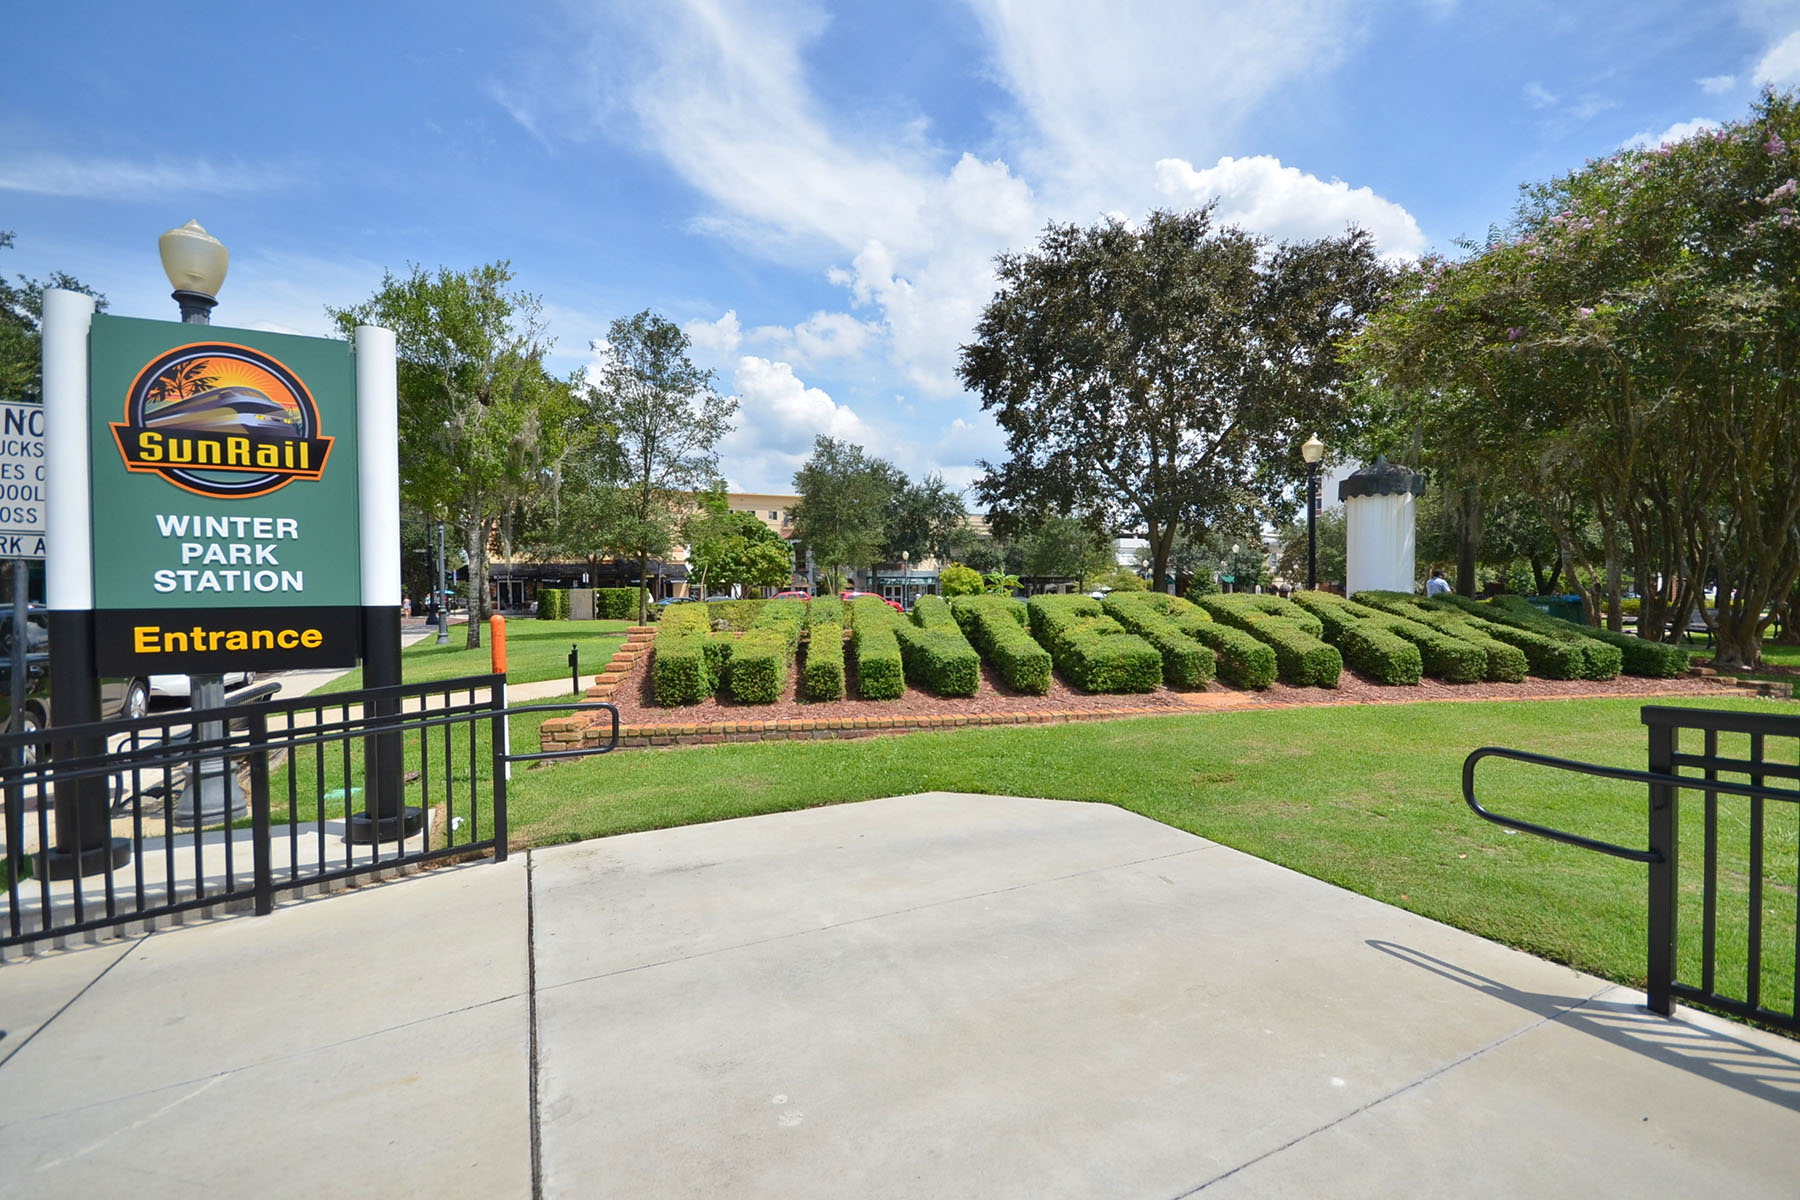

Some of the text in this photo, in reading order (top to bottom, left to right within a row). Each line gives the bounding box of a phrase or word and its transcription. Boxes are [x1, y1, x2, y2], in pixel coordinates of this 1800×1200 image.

[4, 407, 44, 437] NO
[138, 431, 309, 469] SunRail
[155, 514, 299, 540] WINTER
[181, 542, 279, 566] PARK
[153, 569, 304, 593] STATION
[133, 625, 323, 654] Entrance
